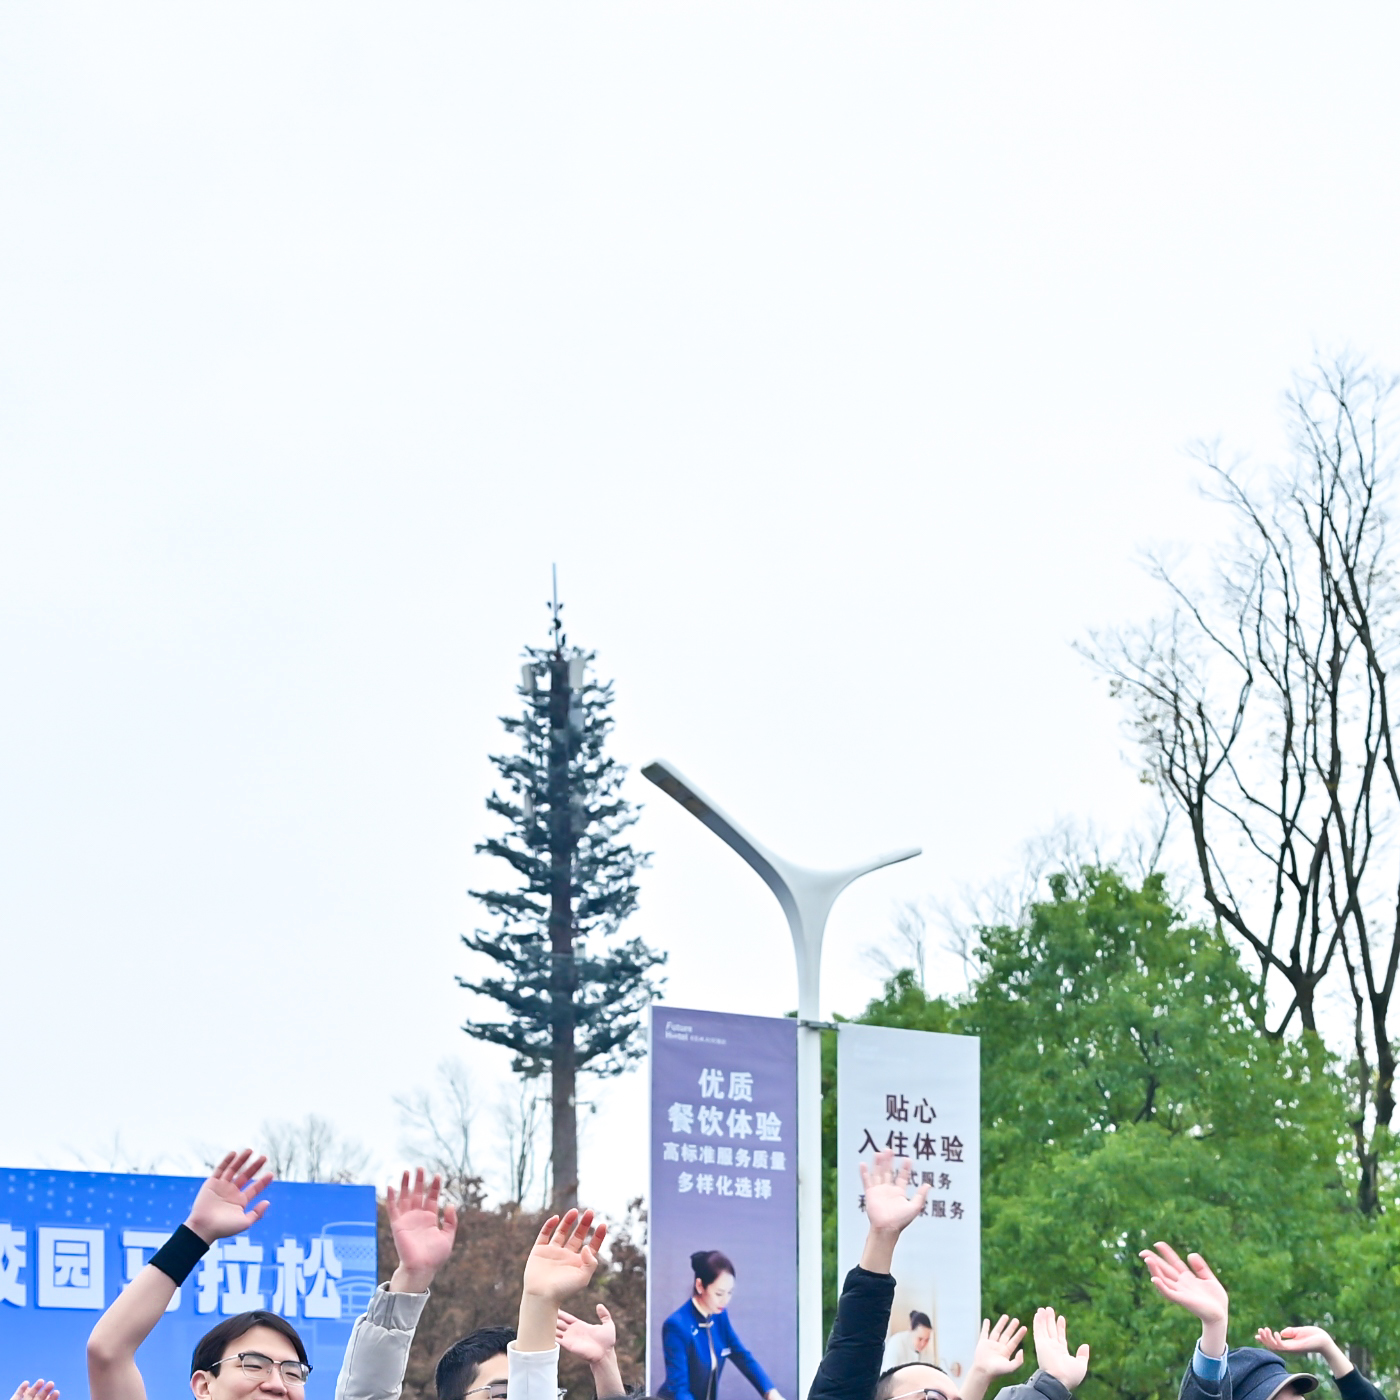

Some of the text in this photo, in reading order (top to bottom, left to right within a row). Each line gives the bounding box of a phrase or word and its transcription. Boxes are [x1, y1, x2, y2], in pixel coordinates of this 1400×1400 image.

[698, 1068, 753, 1102] 优质
[668, 1102, 782, 1141] 餐饮体验
[886, 1094, 936, 1124] 贴心
[663, 1142, 786, 1171] 高标准服务质量
[858, 1128, 964, 1163] 入住体验
[678, 1171, 772, 1200] 多样化选择
